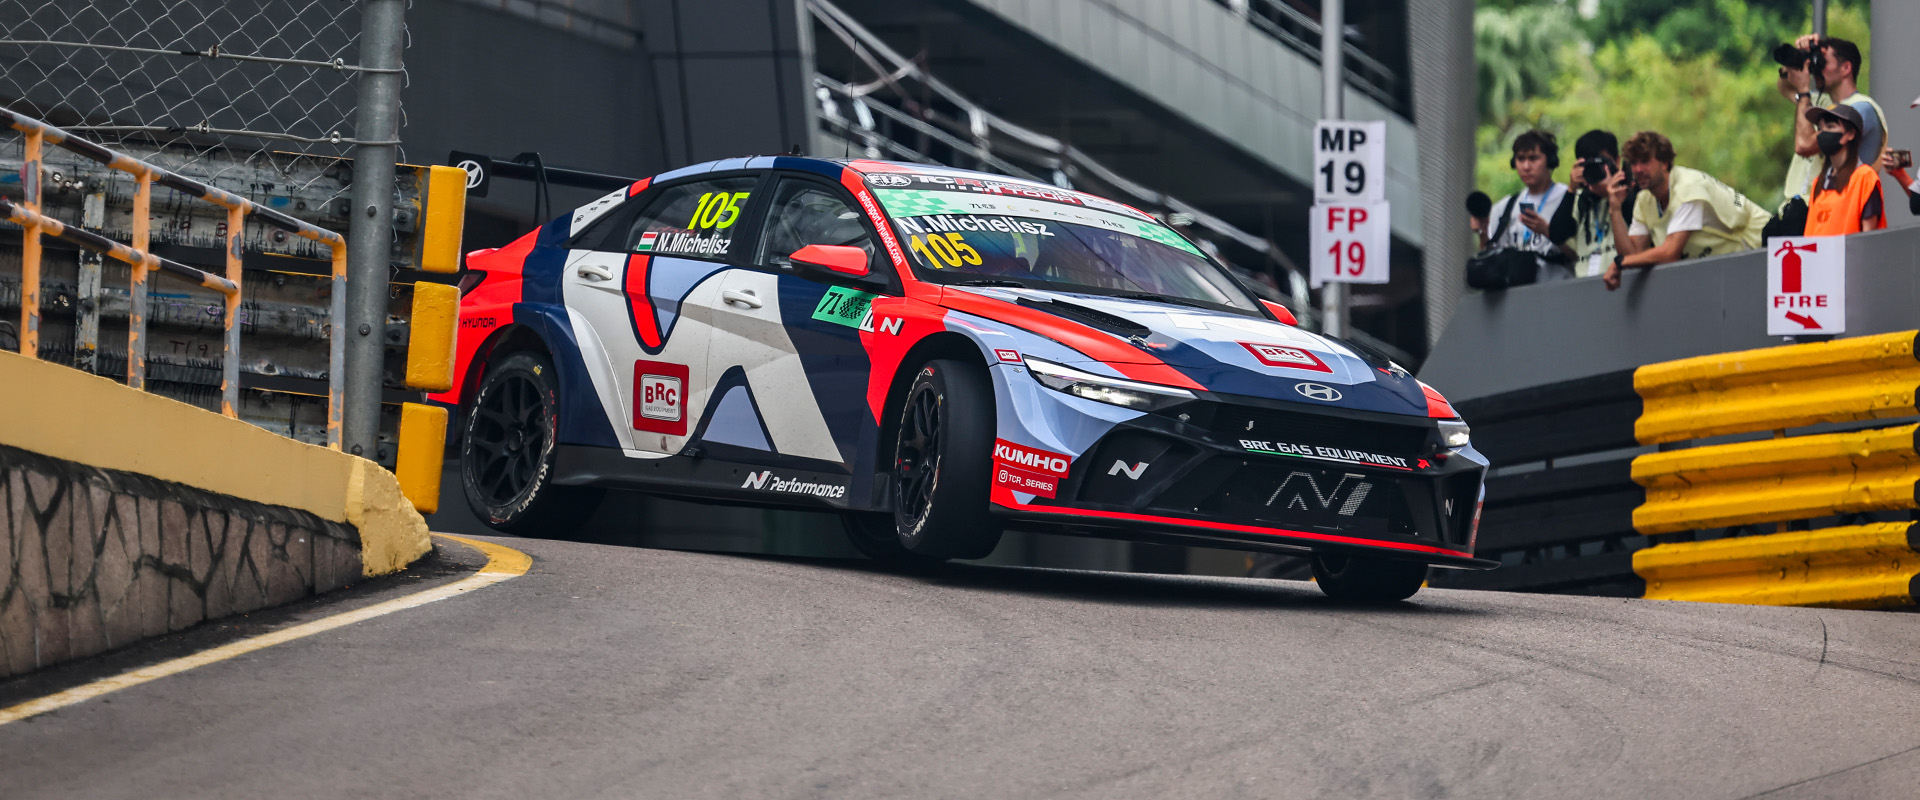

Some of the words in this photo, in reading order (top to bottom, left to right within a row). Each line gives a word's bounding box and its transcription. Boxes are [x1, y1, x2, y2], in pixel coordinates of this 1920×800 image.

[1320, 127, 1366, 152] MP
[868, 175, 907, 184] FIA
[911, 174, 984, 187] TCR
[1320, 160, 1366, 194] 19
[687, 191, 750, 230] 105
[1327, 207, 1368, 232] FP
[858, 190, 903, 266] motorsport.hyundai.com
[893, 214, 1055, 236] N.Michelisz
[656, 232, 732, 254] N.Michelisz
[910, 232, 983, 269] 105
[1328, 240, 1366, 276] 19
[818, 291, 844, 315] 71
[1774, 295, 1828, 308] FIRE
[462, 317, 496, 328] HYUNDAI
[1262, 348, 1304, 358] BRC
[645, 382, 676, 406] BRC
[995, 443, 1067, 473] KUMHO
[1239, 440, 1275, 451] BRC
[1277, 442, 1313, 455] GAS
[1315, 446, 1408, 468] EQUIPMENT
[517, 463, 549, 513] KUMHO
[770, 476, 845, 498] Performance
[1008, 474, 1053, 491] TCR_SERIES
